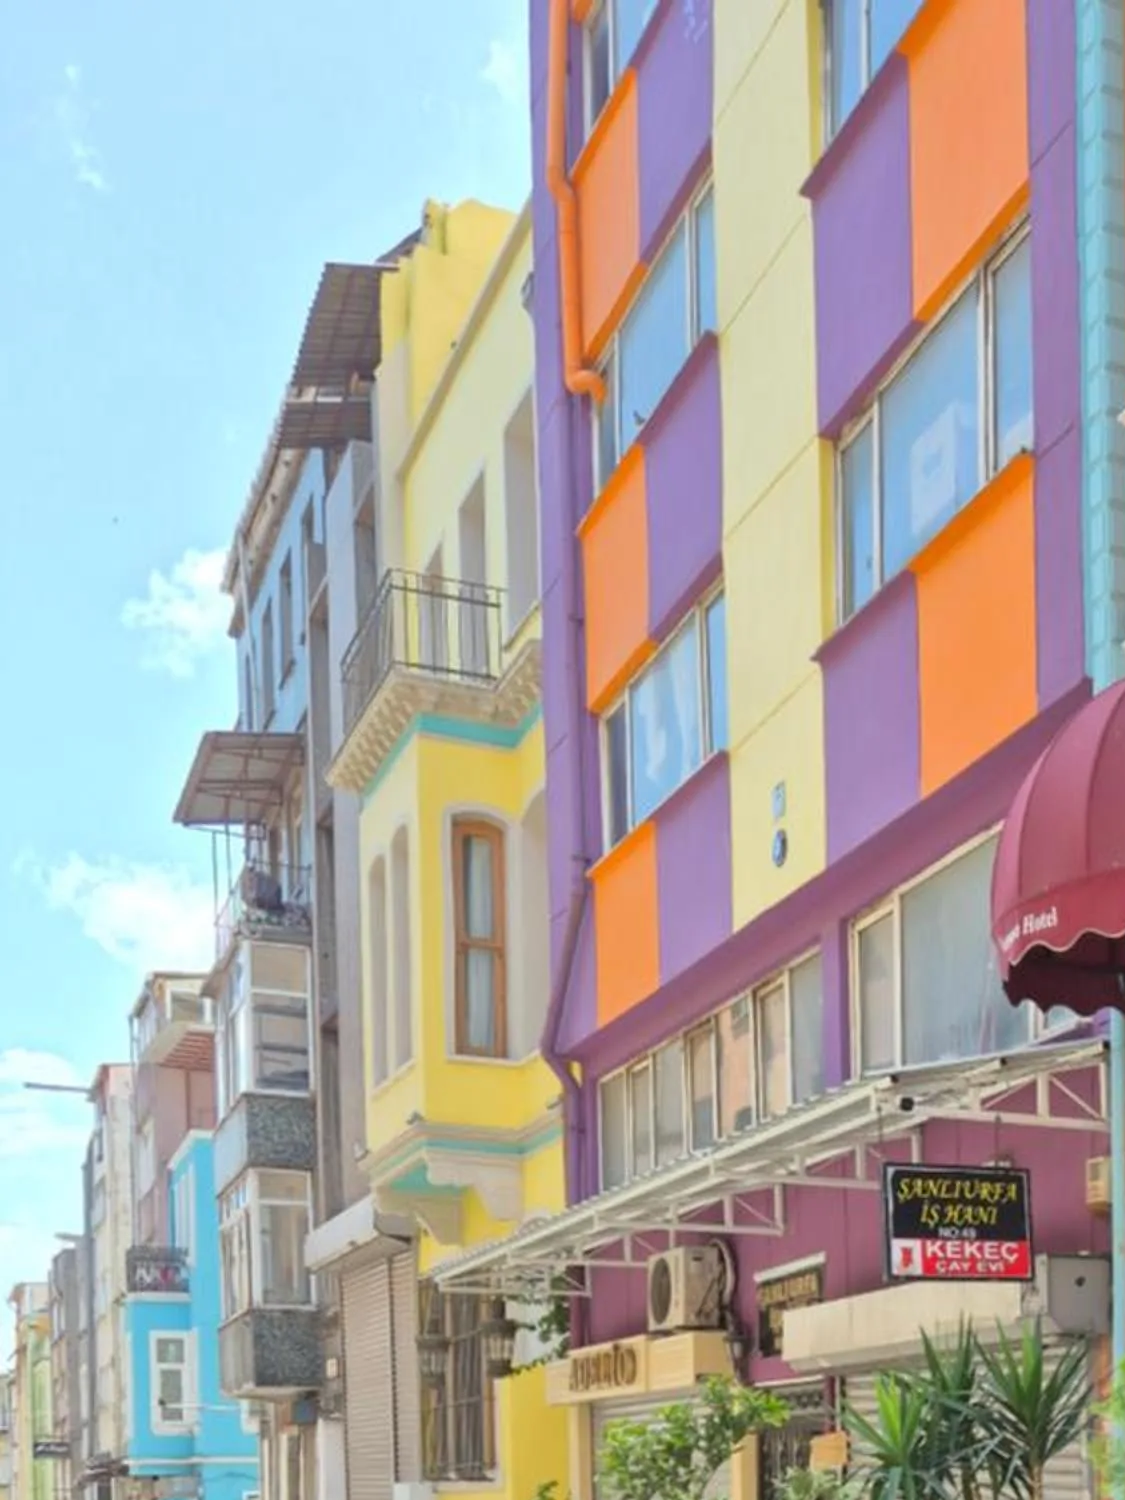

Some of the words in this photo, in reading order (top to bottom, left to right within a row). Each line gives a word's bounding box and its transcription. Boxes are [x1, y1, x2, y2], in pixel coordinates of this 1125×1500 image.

[898, 1176, 1018, 1203] ŞANLIURFA
[925, 1239, 1020, 1264] KEKEÇ
[935, 1259, 973, 1273] ÇAY
